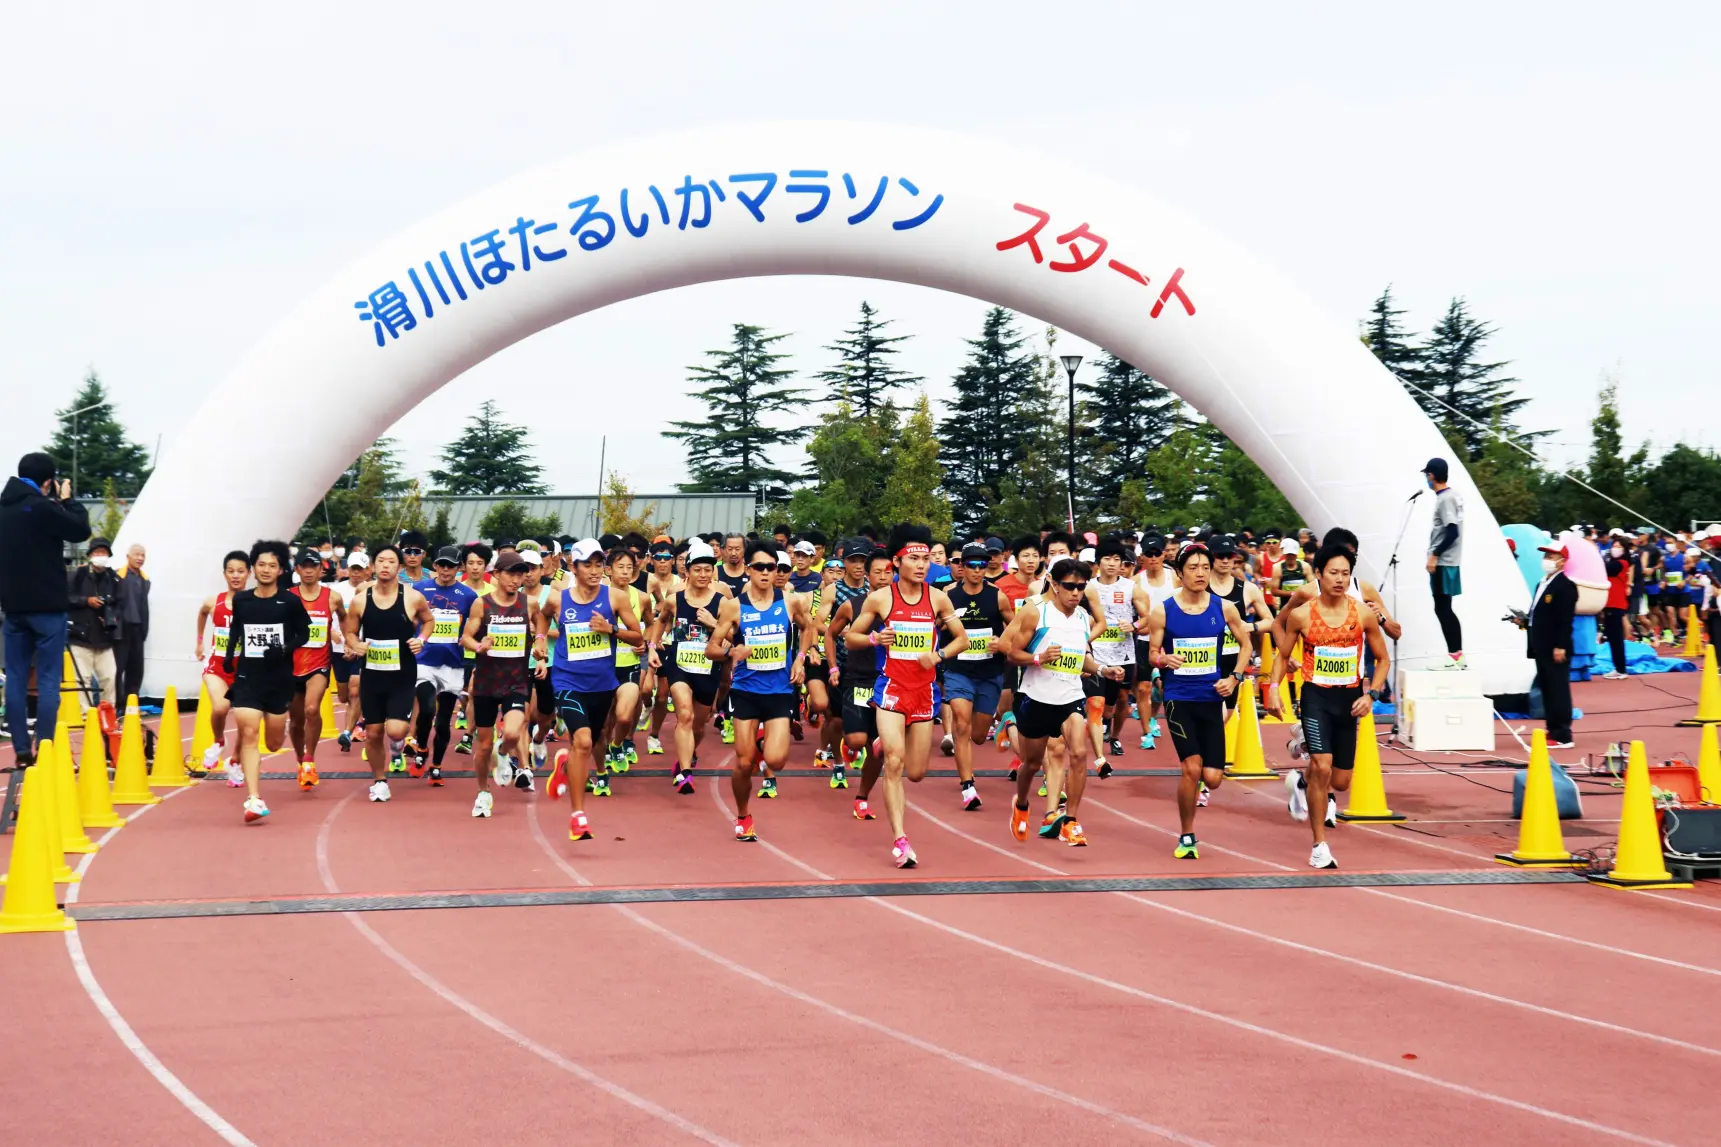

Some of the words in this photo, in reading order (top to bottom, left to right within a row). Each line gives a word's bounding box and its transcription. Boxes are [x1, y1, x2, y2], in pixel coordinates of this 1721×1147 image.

[354, 170, 943, 347] 滑川ほたるいかマラソン
[996, 204, 1195, 318] スタート
[433, 624, 452, 634] 2355
[569, 634, 602, 649] A20149
[891, 634, 925, 648] A20103
[367, 650, 392, 661] A20104
[678, 652, 706, 663] A22218
[1044, 656, 1077, 669] 21409
[1316, 658, 1349, 673] A20081
